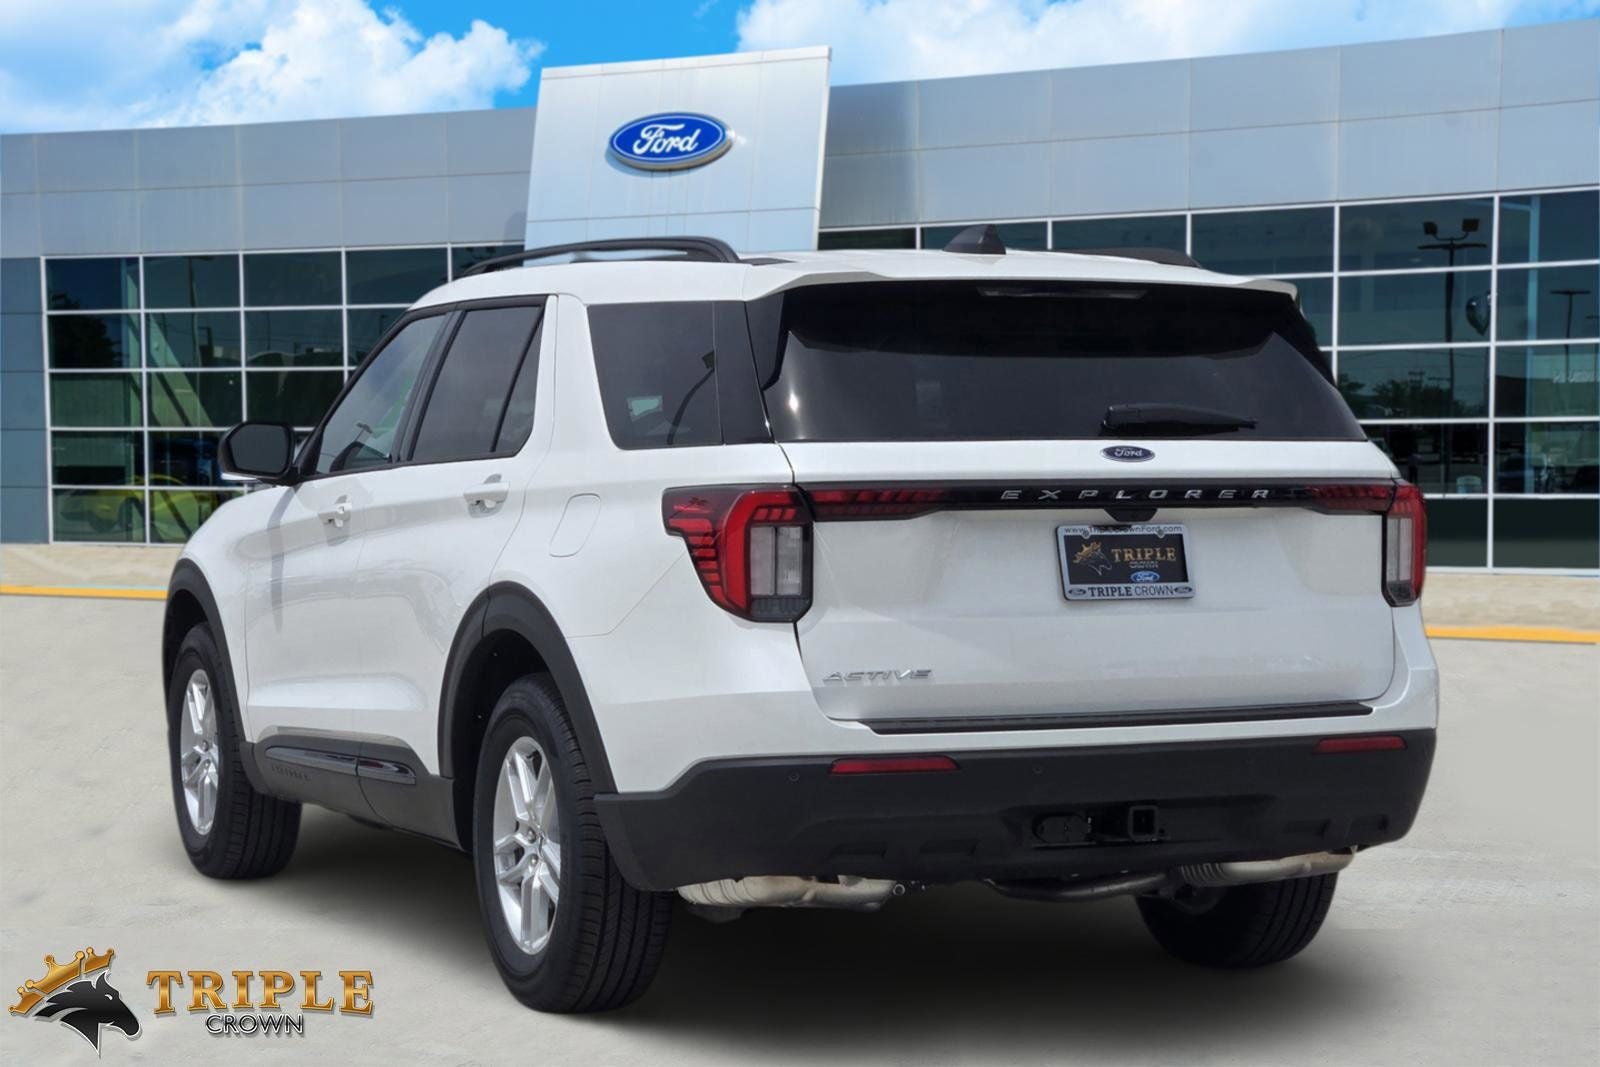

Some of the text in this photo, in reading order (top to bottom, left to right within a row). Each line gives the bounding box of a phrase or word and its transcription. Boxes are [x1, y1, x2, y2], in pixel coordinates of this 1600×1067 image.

[632, 123, 702, 155] Ford
[1001, 489, 1269, 500] EXPLORER
[1064, 525, 1182, 534] www.TrownFord.com
[1111, 548, 1176, 562] TRIPLE
[1088, 586, 1132, 597] TRIPLE
[1134, 585, 1174, 596] CROWN
[822, 669, 932, 681] ACTIVE
